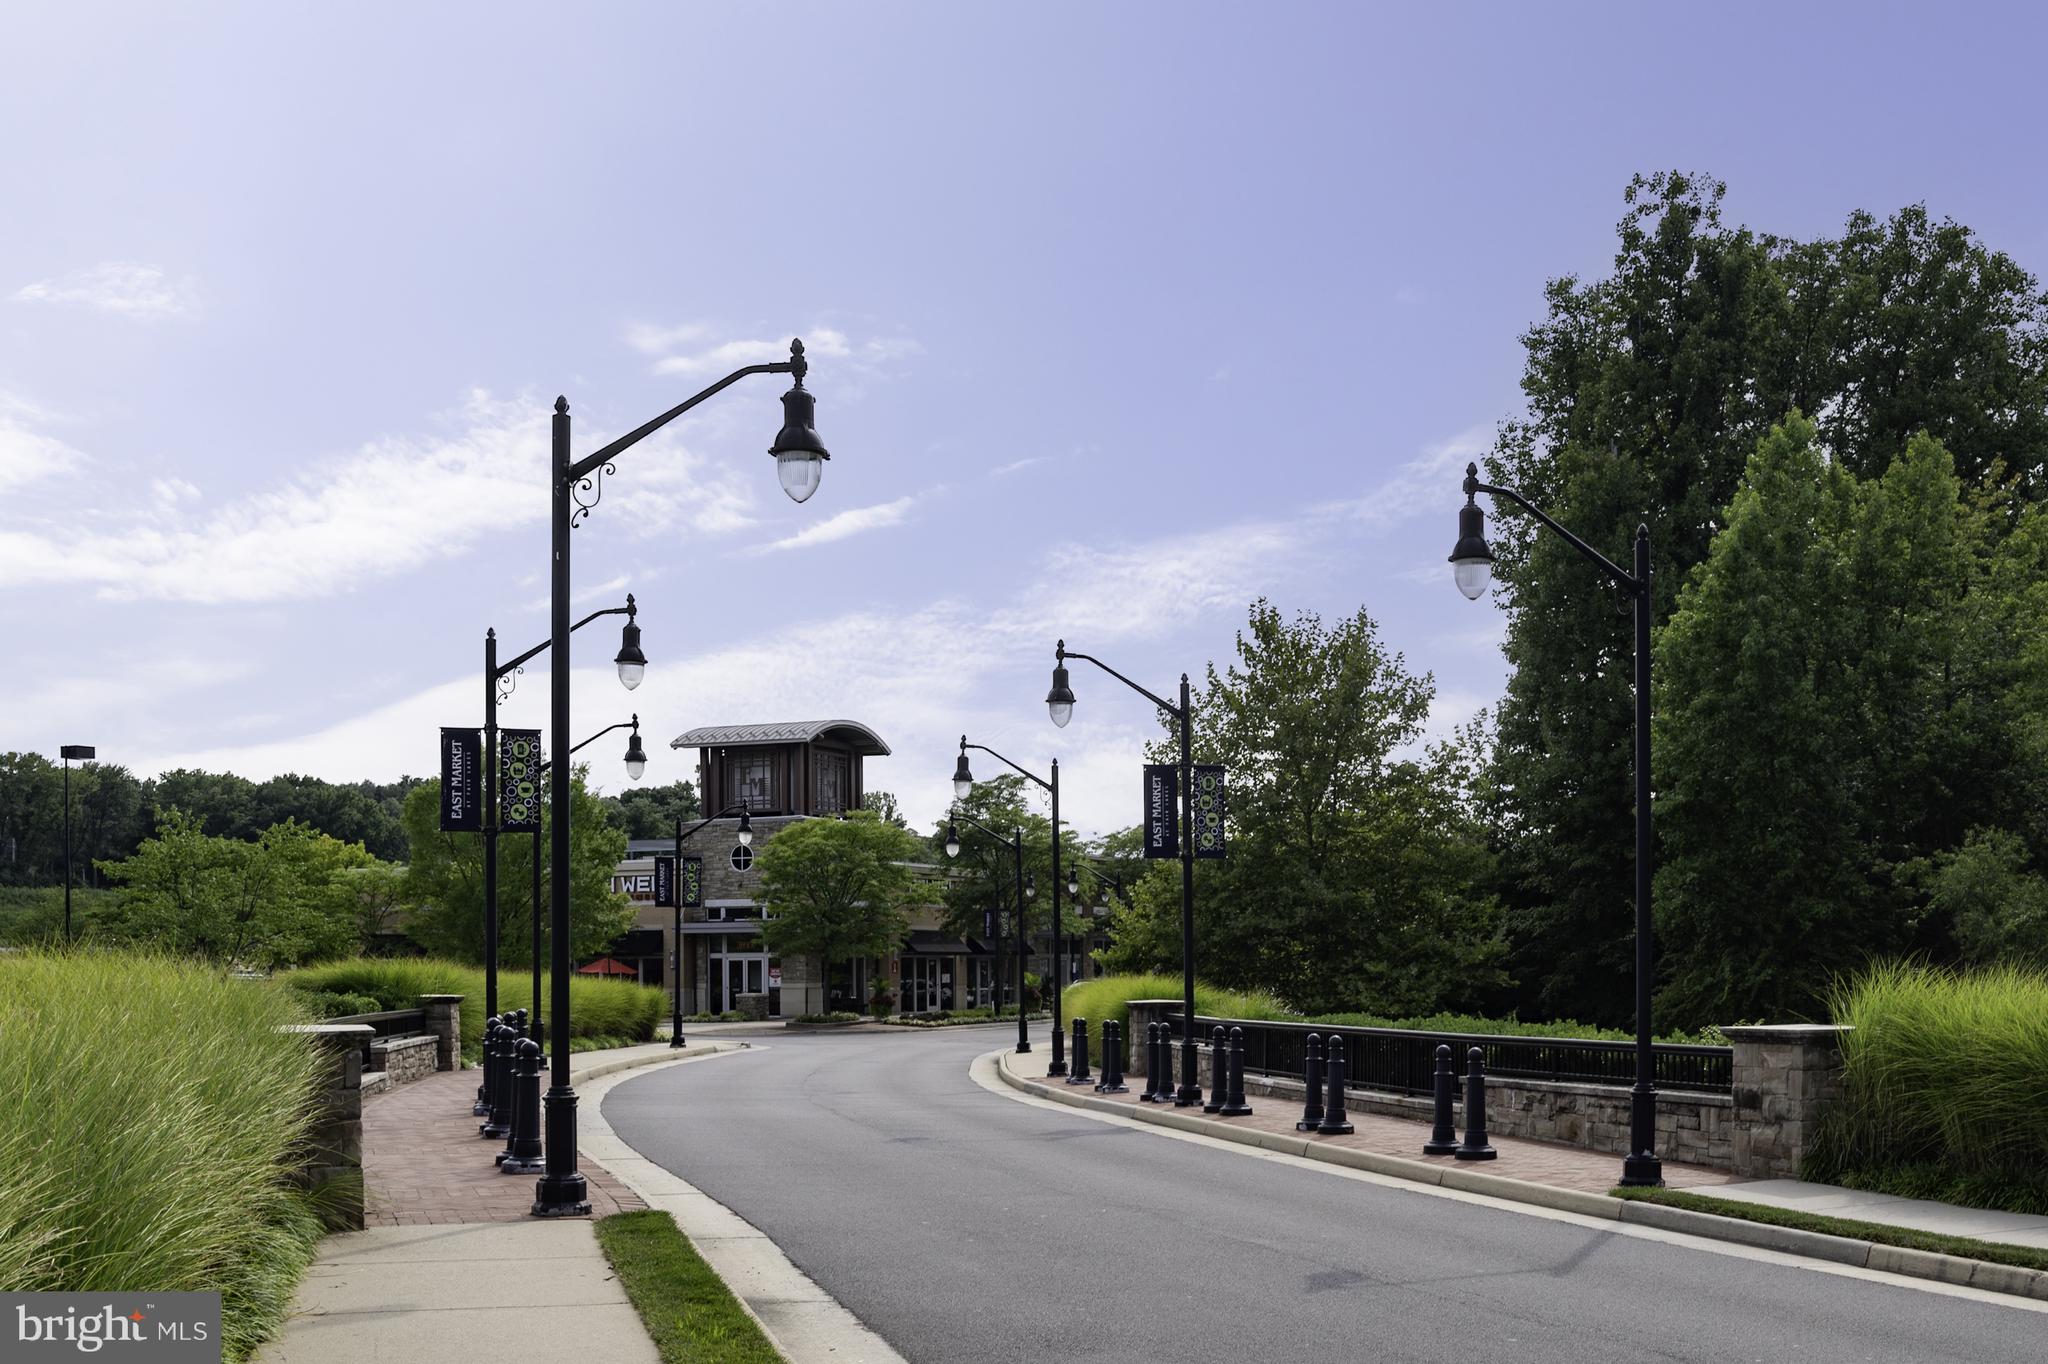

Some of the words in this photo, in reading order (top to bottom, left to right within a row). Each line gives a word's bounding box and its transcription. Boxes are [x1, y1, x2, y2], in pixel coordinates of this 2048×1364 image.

[451, 740, 462, 787] MARKET
[451, 789, 462, 819] EAST
[1152, 775, 1162, 818] MARKET
[1153, 820, 1163, 847] EAST
